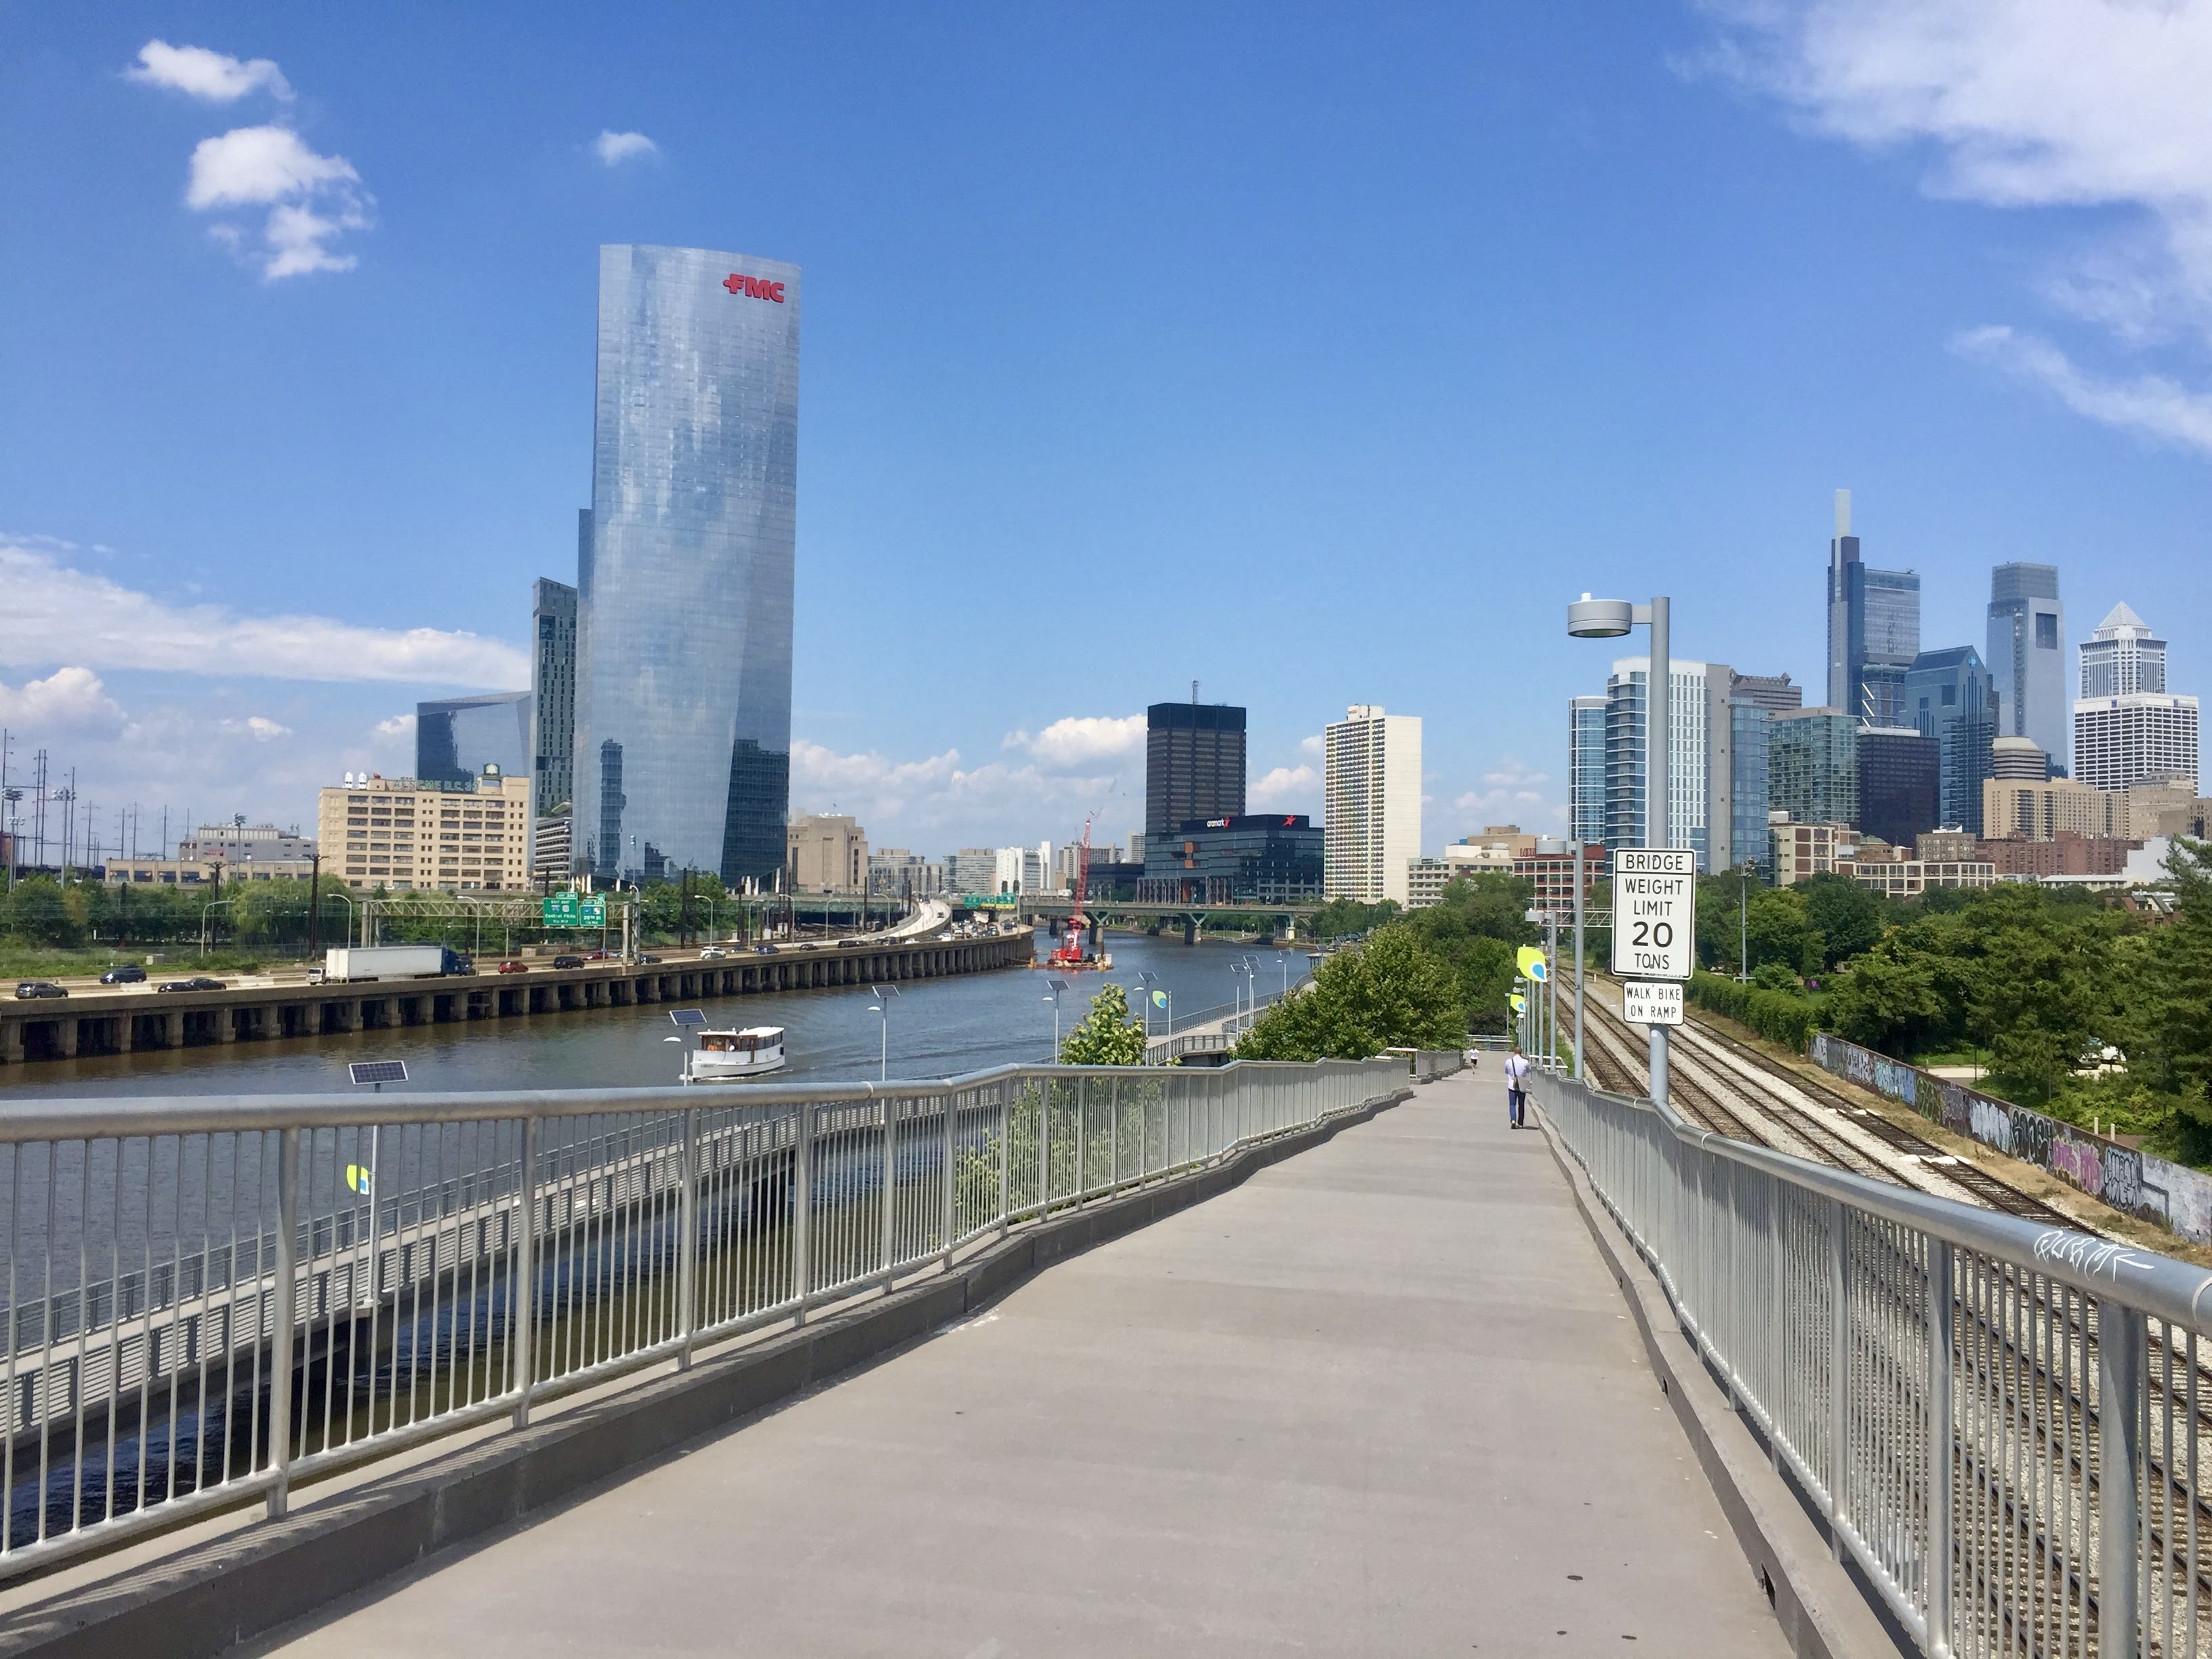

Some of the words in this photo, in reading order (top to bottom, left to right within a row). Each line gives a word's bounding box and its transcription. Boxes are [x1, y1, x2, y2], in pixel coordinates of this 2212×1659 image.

[722, 273, 784, 304] FMC
[1626, 854, 1683, 870] BRIDGE
[1625, 878, 1683, 895] WEIGHT
[1634, 900, 1673, 916] LIMIT
[1633, 921, 1673, 948] 20
[1635, 953, 1670, 970] TONS
[1626, 987, 1651, 999] WALK
[1659, 989, 1681, 1001] BIKE
[1631, 1005, 1643, 1017] ON
[1651, 1006, 1677, 1018] RAMP
